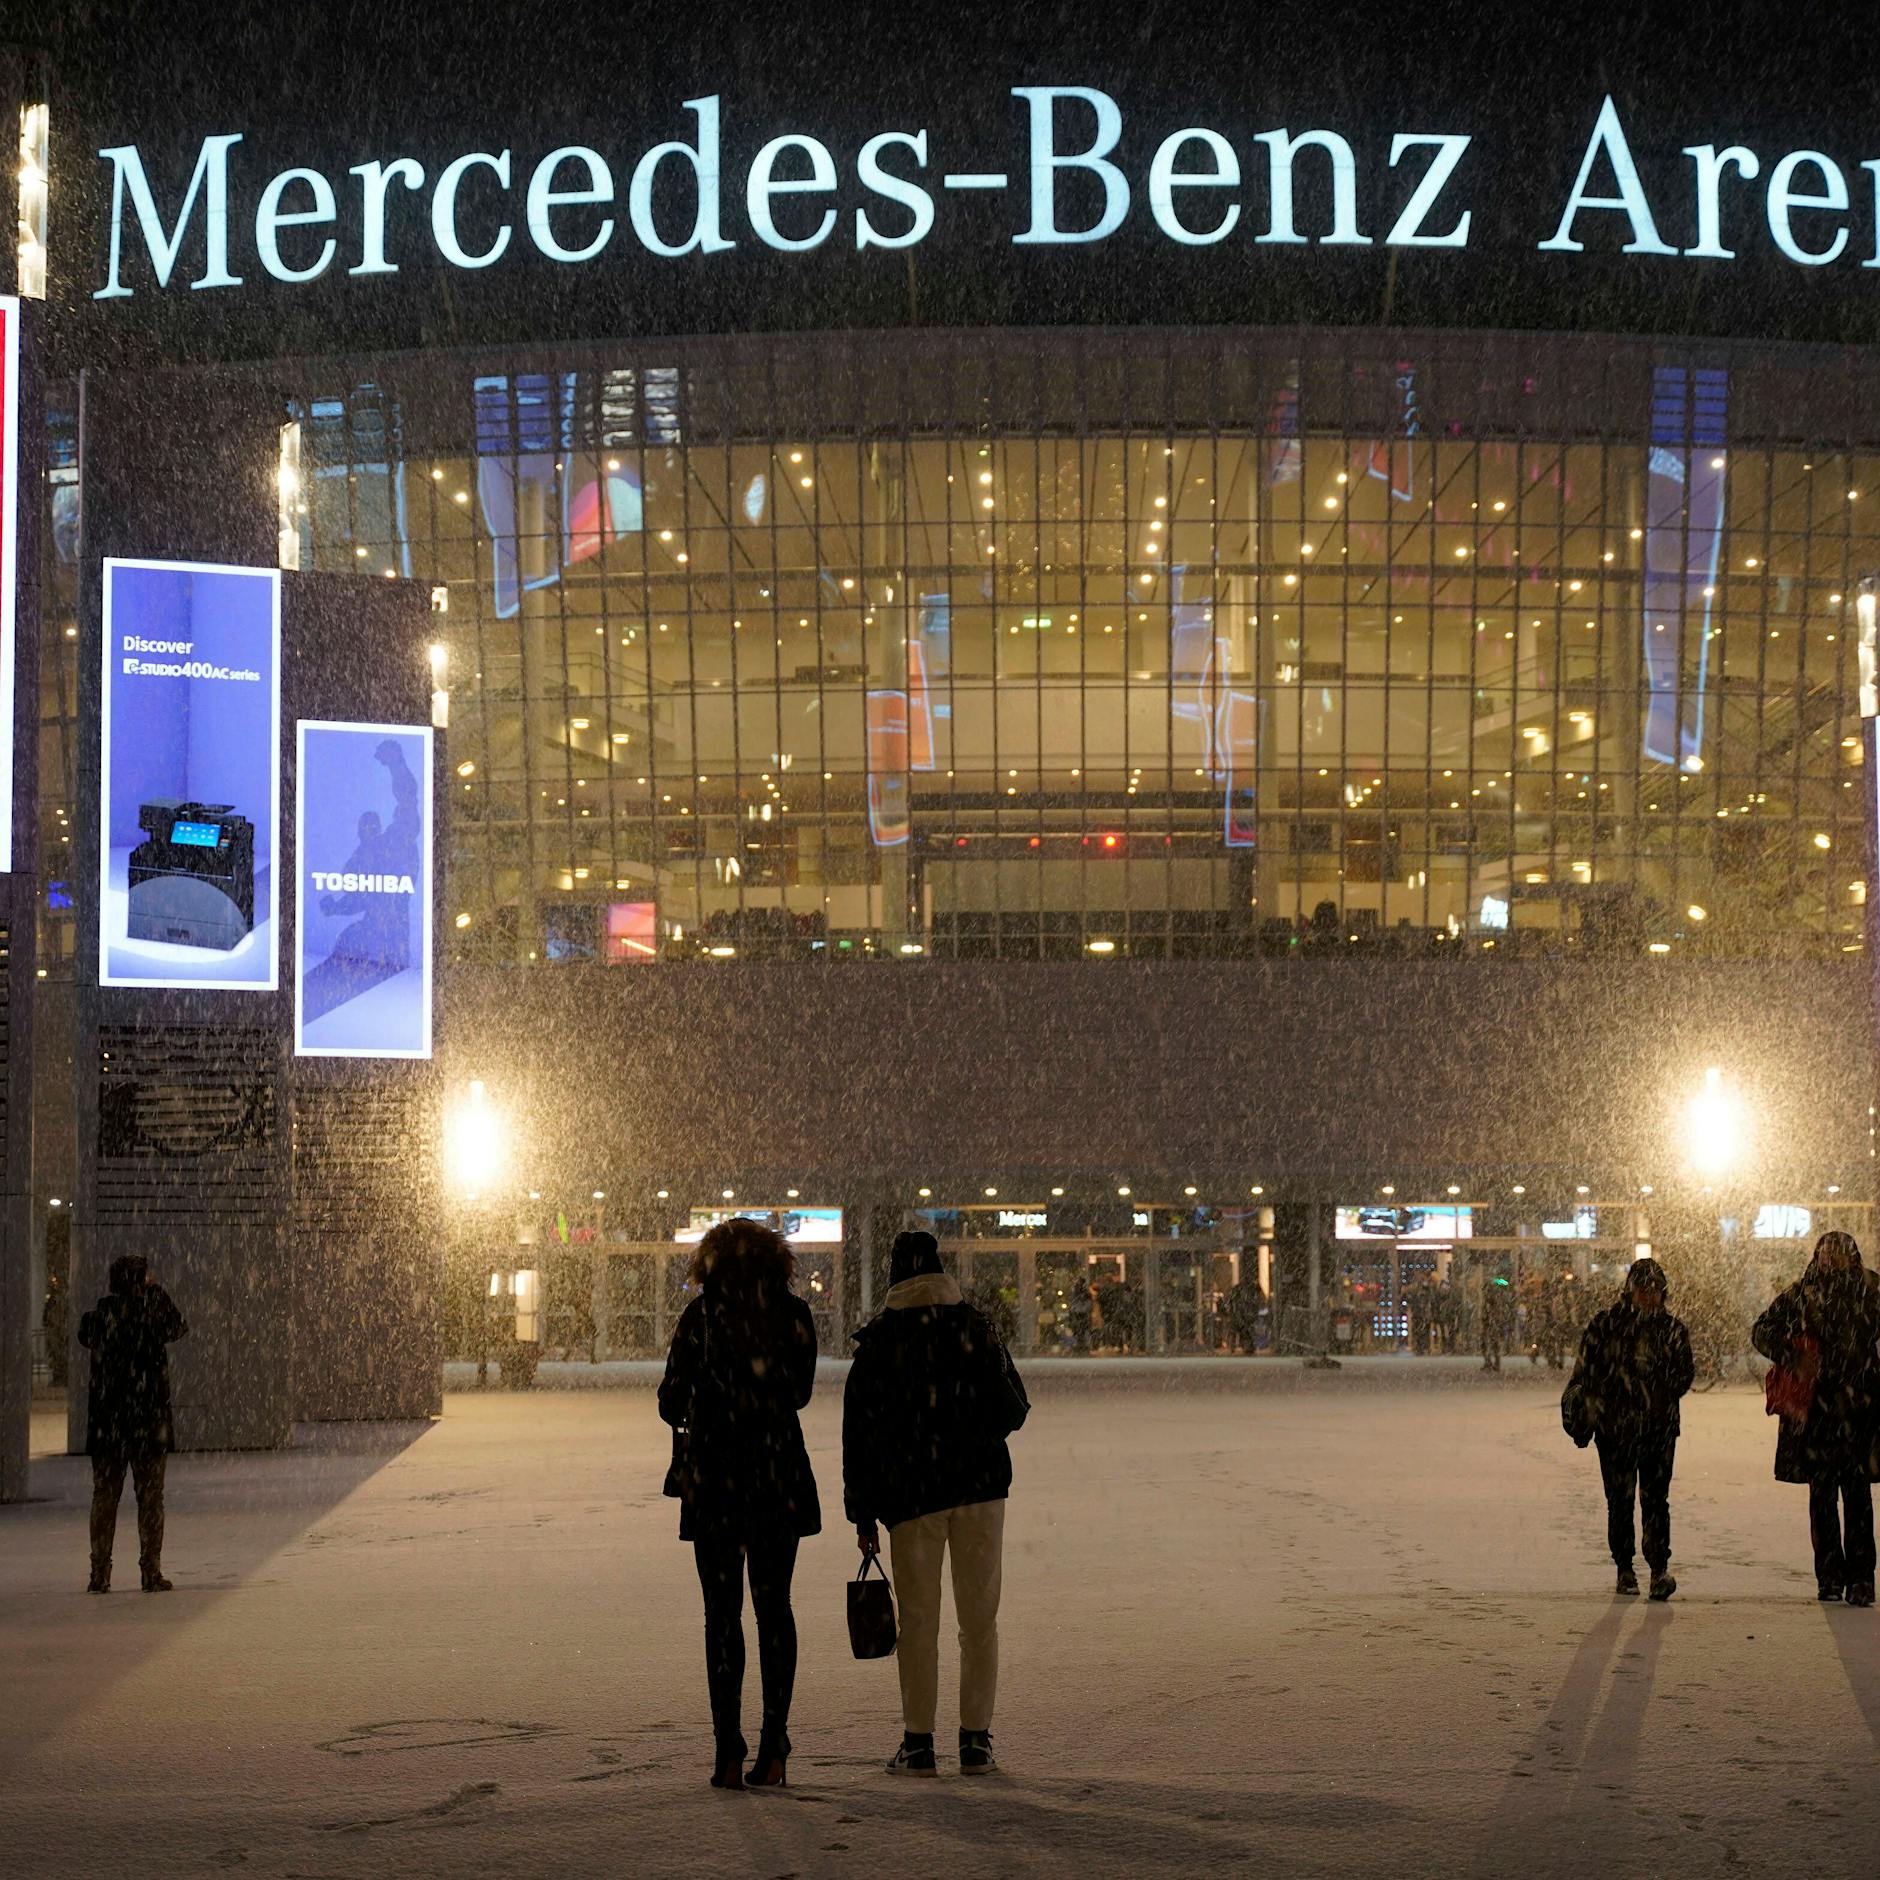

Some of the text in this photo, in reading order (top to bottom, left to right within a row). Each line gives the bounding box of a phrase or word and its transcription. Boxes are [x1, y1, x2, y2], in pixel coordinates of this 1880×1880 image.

[92, 86, 1880, 300] Mercedes-Benz Are
[123, 635, 194, 655] Discover
[229, 669, 260, 681] series
[311, 871, 415, 895] TOSHIBA
